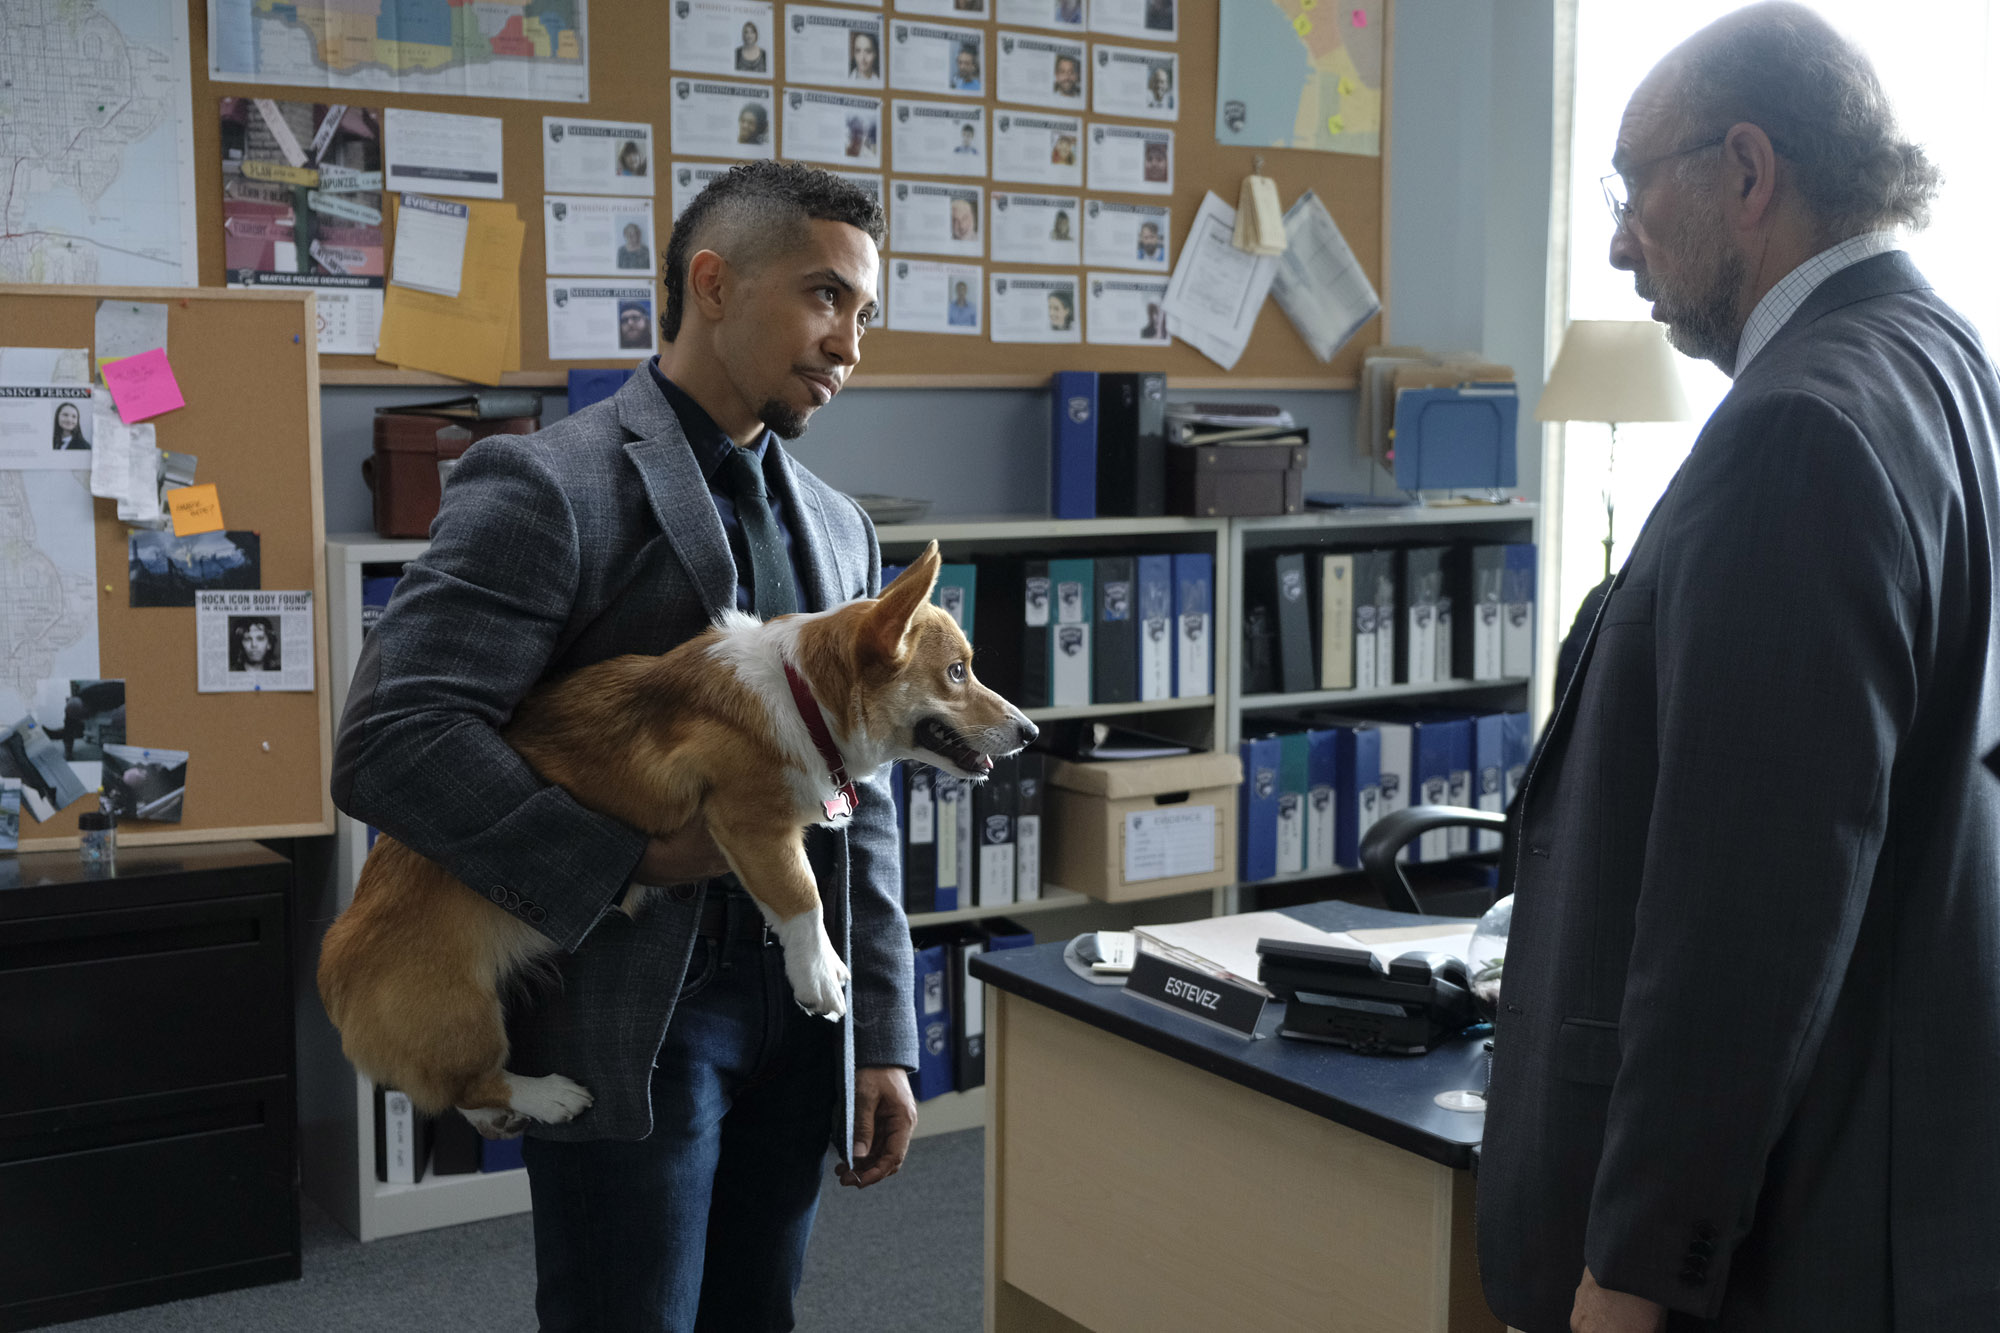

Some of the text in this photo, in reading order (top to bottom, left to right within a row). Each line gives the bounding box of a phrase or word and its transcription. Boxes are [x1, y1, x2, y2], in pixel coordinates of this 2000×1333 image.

[405, 196, 463, 215] EVIDENCE
[260, 274, 370, 286] SEATTLE POLICE DEPARTMENT
[40, 388, 89, 399] PERSON
[229, 594, 250, 604] ICON
[253, 594, 275, 604] BODY
[278, 594, 307, 605] FOUND
[1165, 976, 1221, 1010] ESTEVEZ
